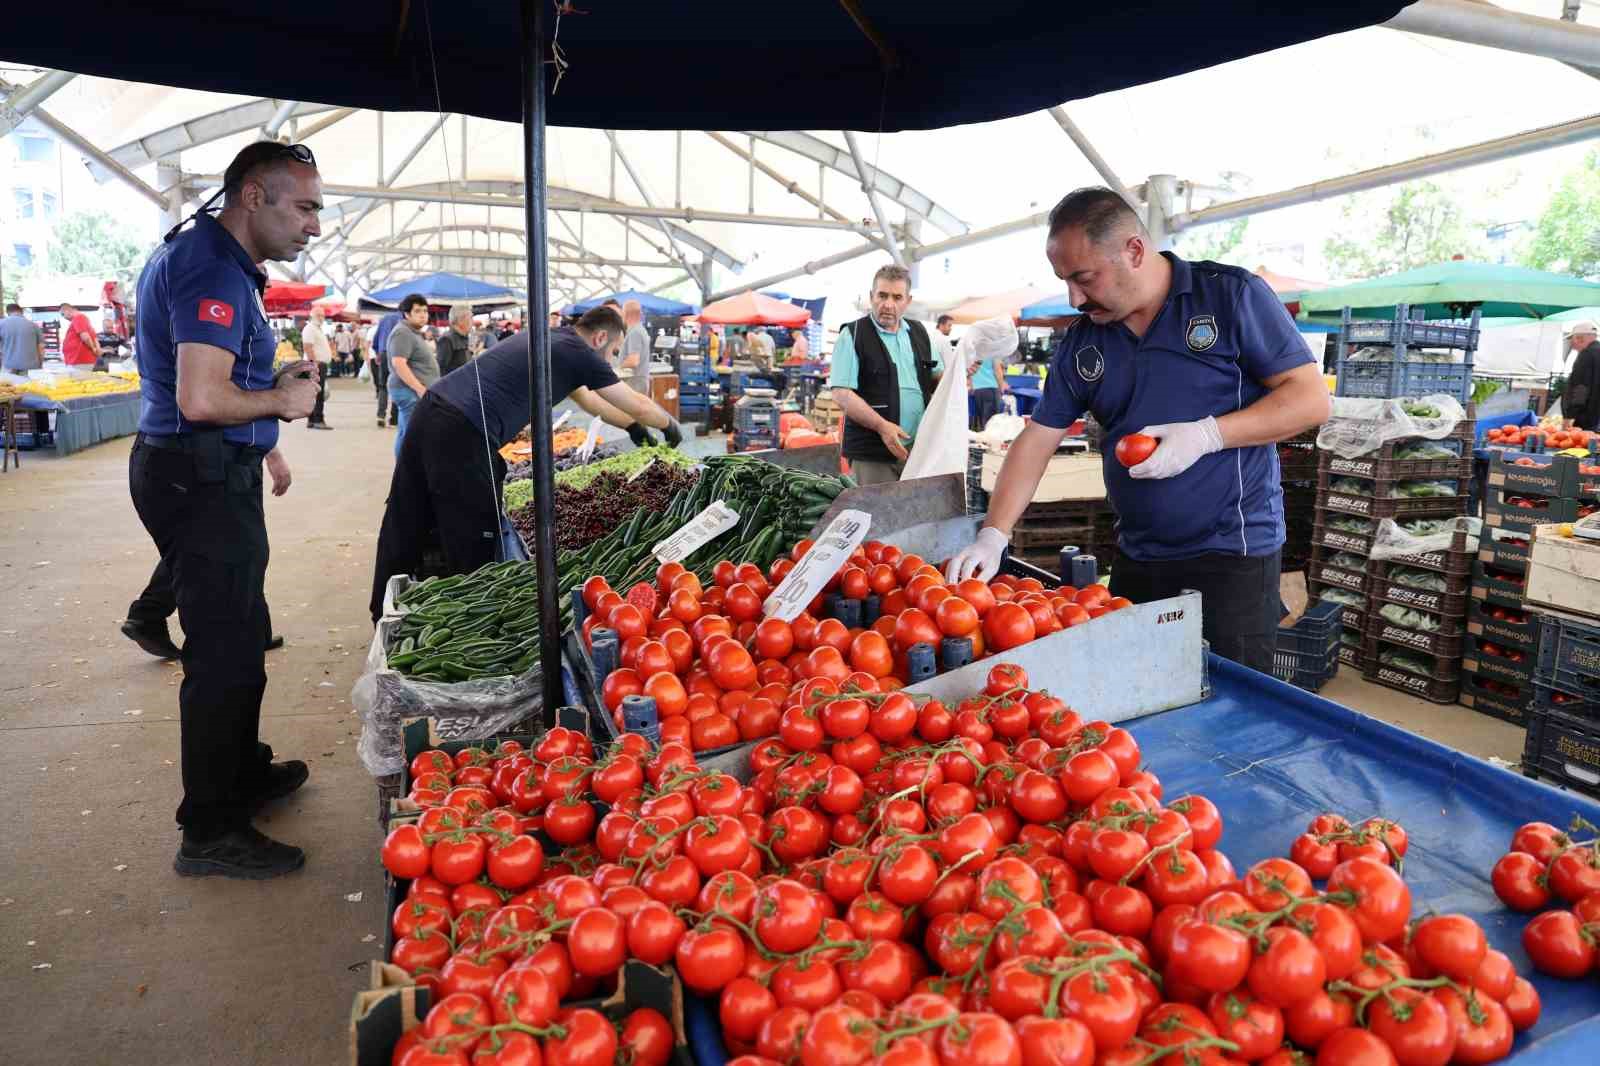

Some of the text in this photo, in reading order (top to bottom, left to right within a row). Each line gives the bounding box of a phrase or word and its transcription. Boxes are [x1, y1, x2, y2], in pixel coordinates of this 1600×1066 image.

[1330, 459, 1372, 470] BESLER
[1328, 496, 1369, 508] BESLER
[1324, 532, 1367, 546] BESLER
[1321, 568, 1362, 583] BESLER
[1388, 588, 1438, 604] BESLER
[1384, 626, 1431, 644] BESLER
[1378, 668, 1428, 688] BESLER
